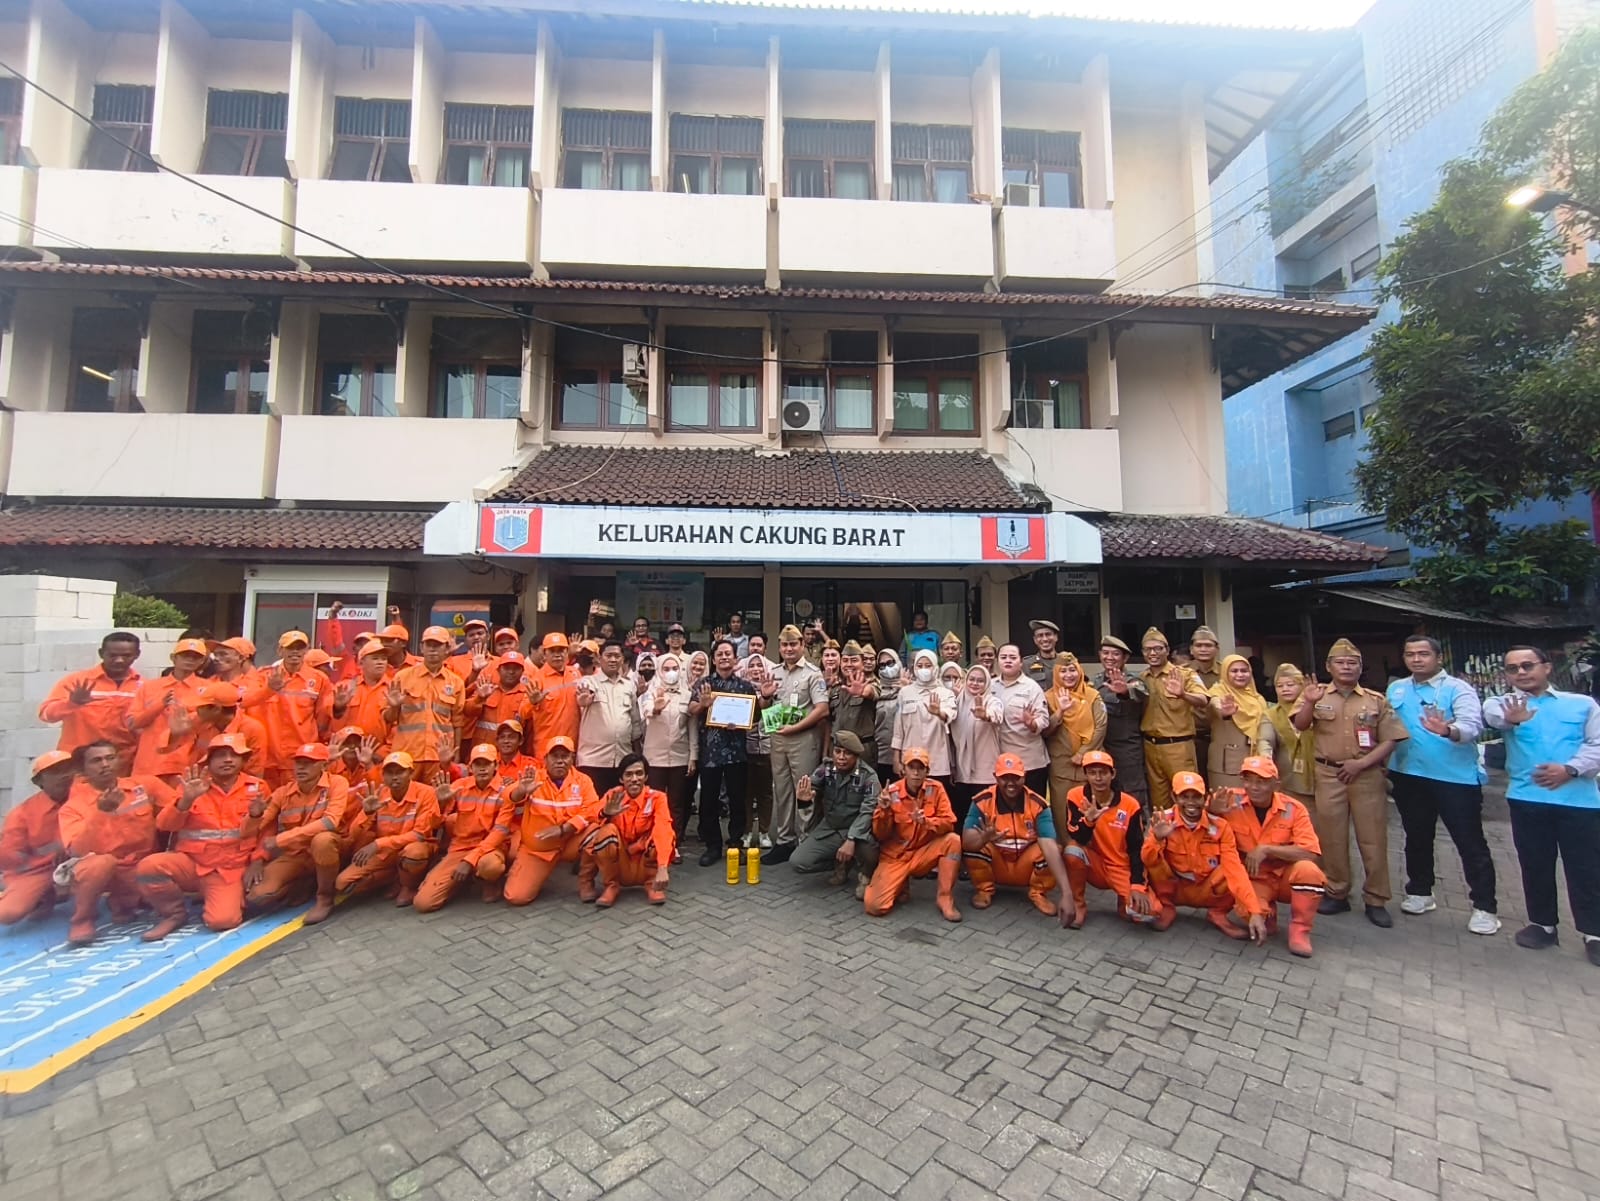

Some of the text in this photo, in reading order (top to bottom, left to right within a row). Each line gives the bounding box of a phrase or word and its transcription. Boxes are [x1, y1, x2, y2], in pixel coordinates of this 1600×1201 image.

[598, 523, 906, 547] KELURAHAN CAKUNG BARAT
